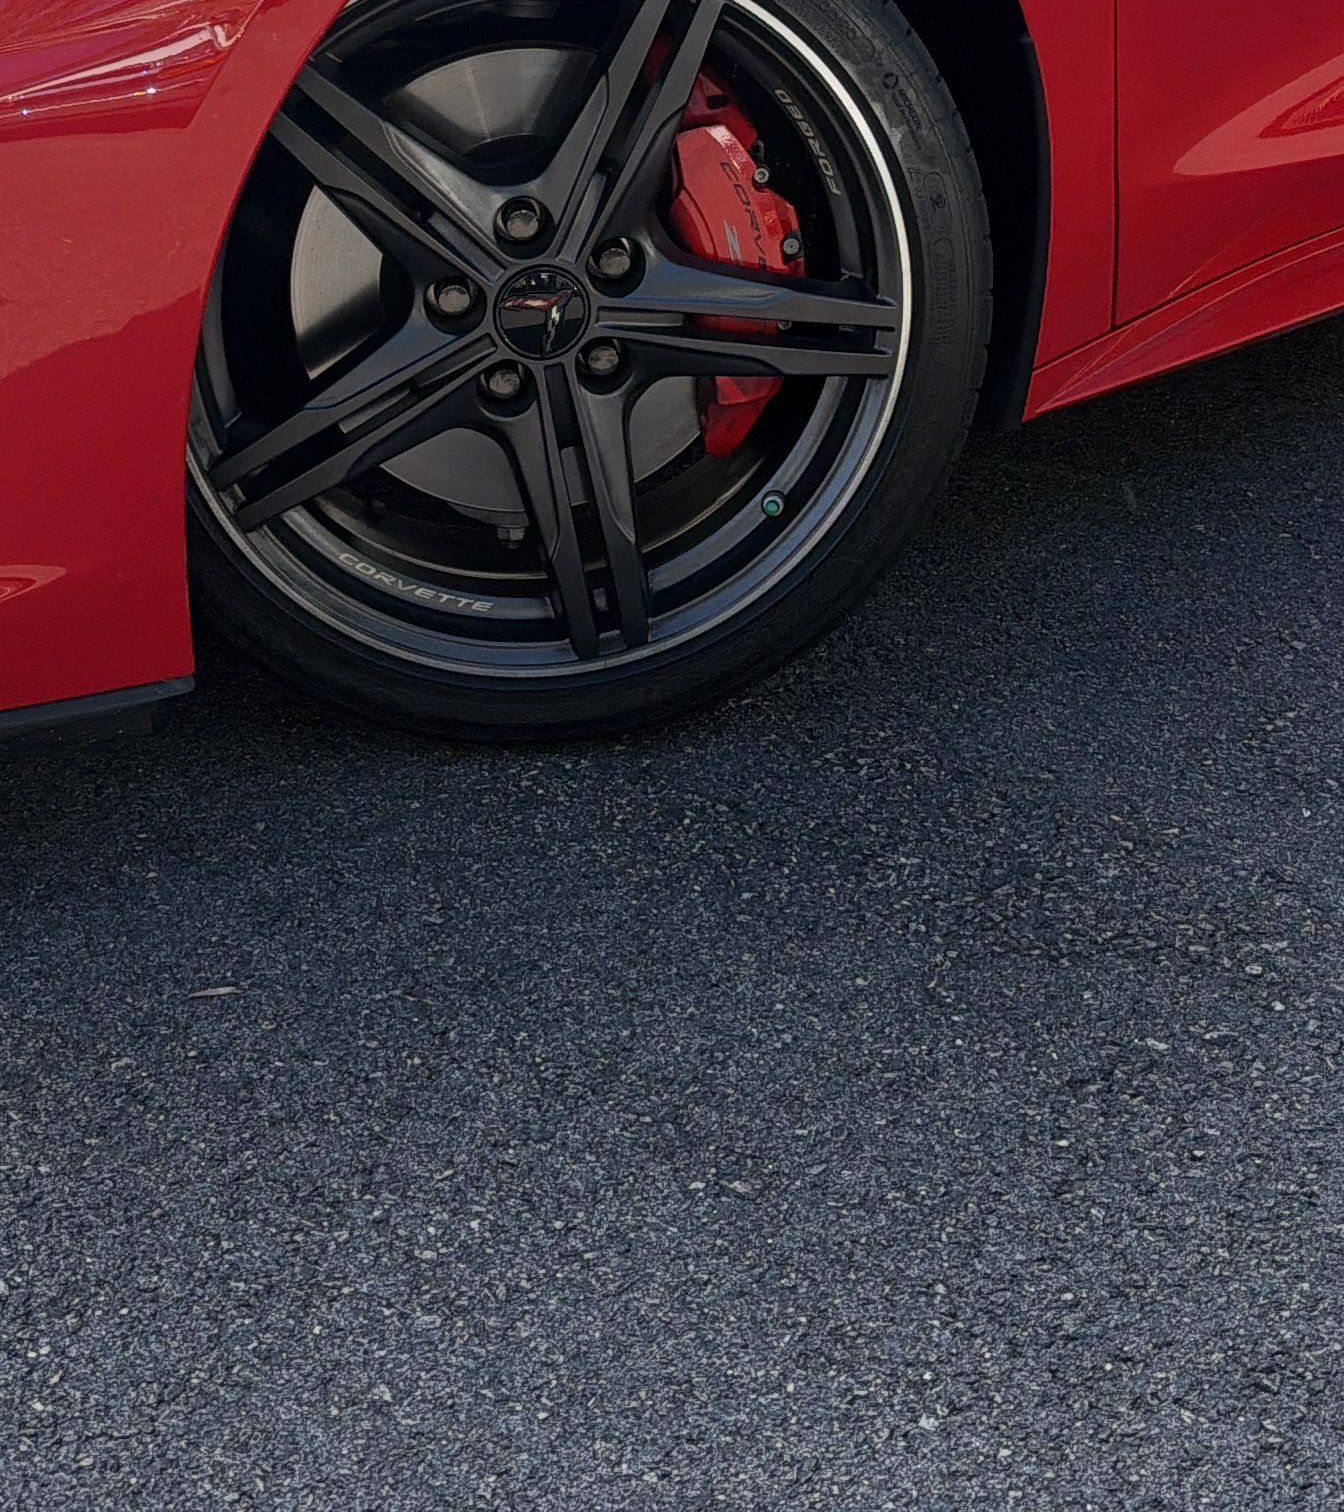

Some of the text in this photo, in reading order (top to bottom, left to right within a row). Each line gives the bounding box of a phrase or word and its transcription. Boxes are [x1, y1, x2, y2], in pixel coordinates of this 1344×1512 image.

[774, 88, 842, 197] FORGED
[719, 161, 769, 271] CORVE
[338, 551, 495, 612] CORVETTE
